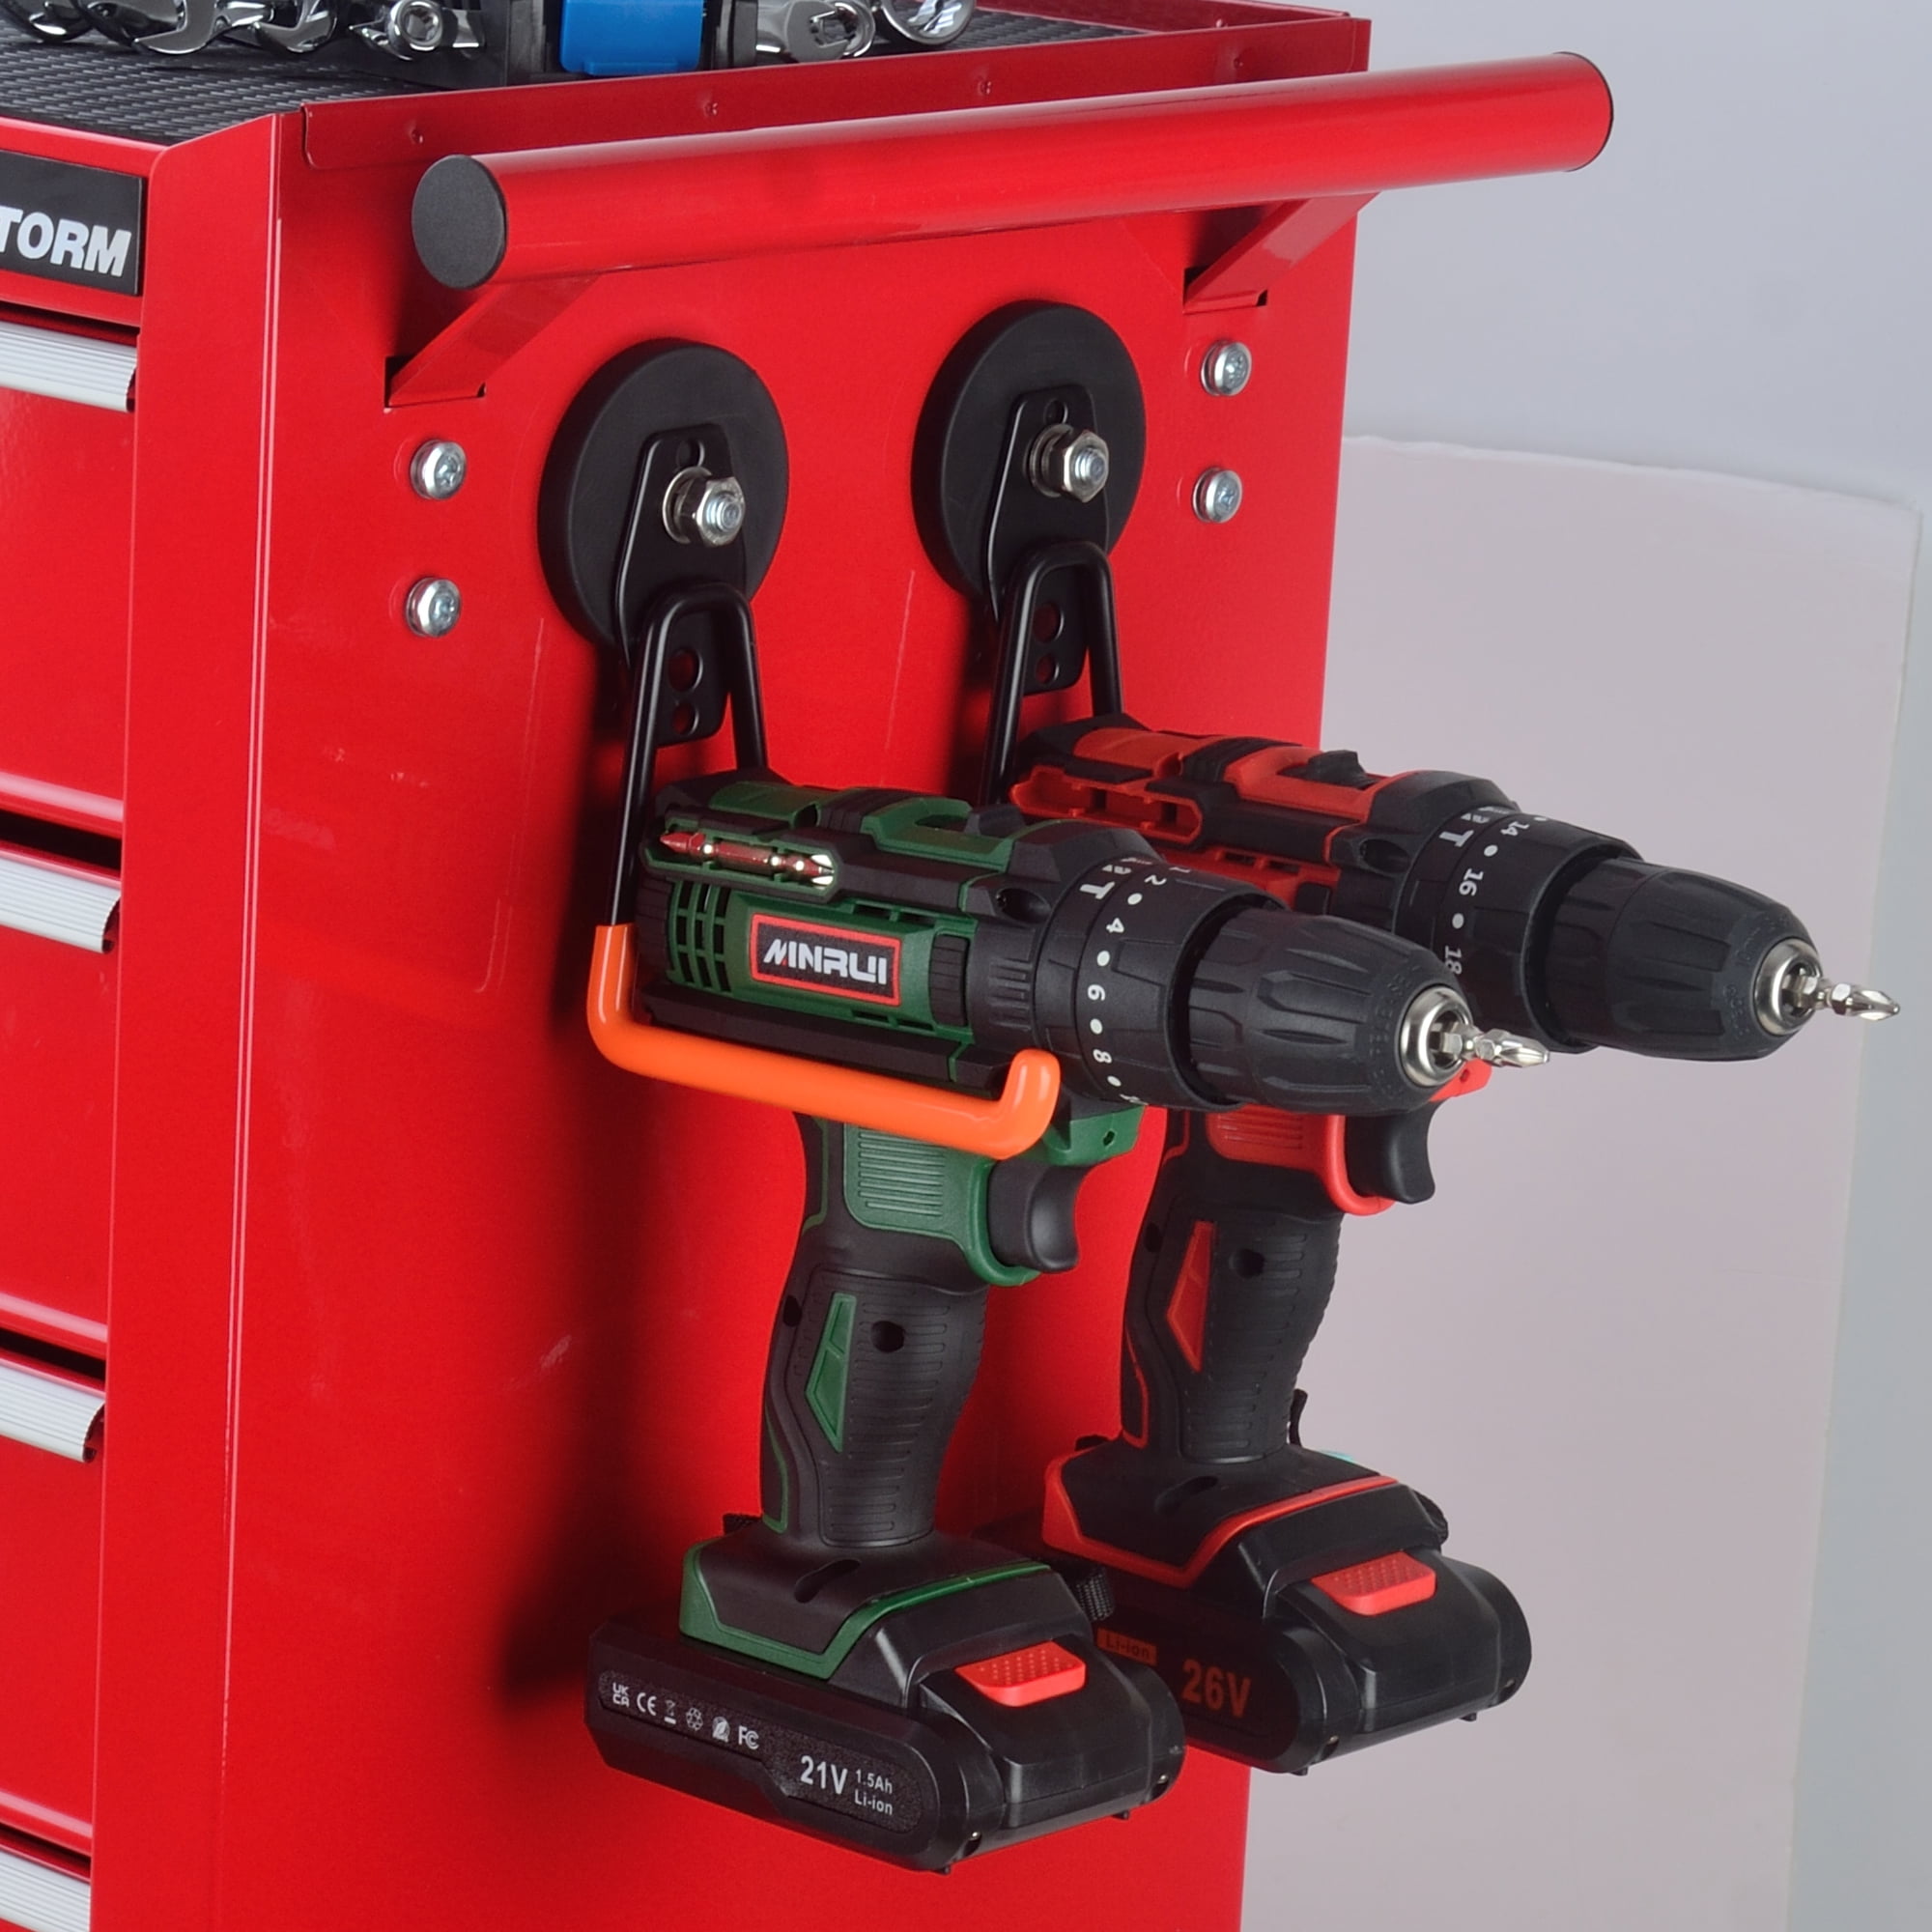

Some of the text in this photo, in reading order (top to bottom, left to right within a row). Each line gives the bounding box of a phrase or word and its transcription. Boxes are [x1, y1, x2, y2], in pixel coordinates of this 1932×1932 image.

[1500, 821, 1530, 837] 14
[1144, 874, 1167, 886] 2
[1459, 868, 1484, 895] 16
[1106, 918, 1124, 934] 4
[763, 938, 887, 984] MINRUI
[1445, 945, 1463, 975] 18
[1088, 984, 1106, 1002] 6
[1093, 1049, 1112, 1064] 8
[1105, 1634, 1150, 1661] Li-ion
[1181, 1659, 1251, 1719] 26V
[800, 1755, 848, 1795] 21V
[856, 1769, 893, 1794] 1.5Ah
[854, 1789, 894, 1816] Li-ion
